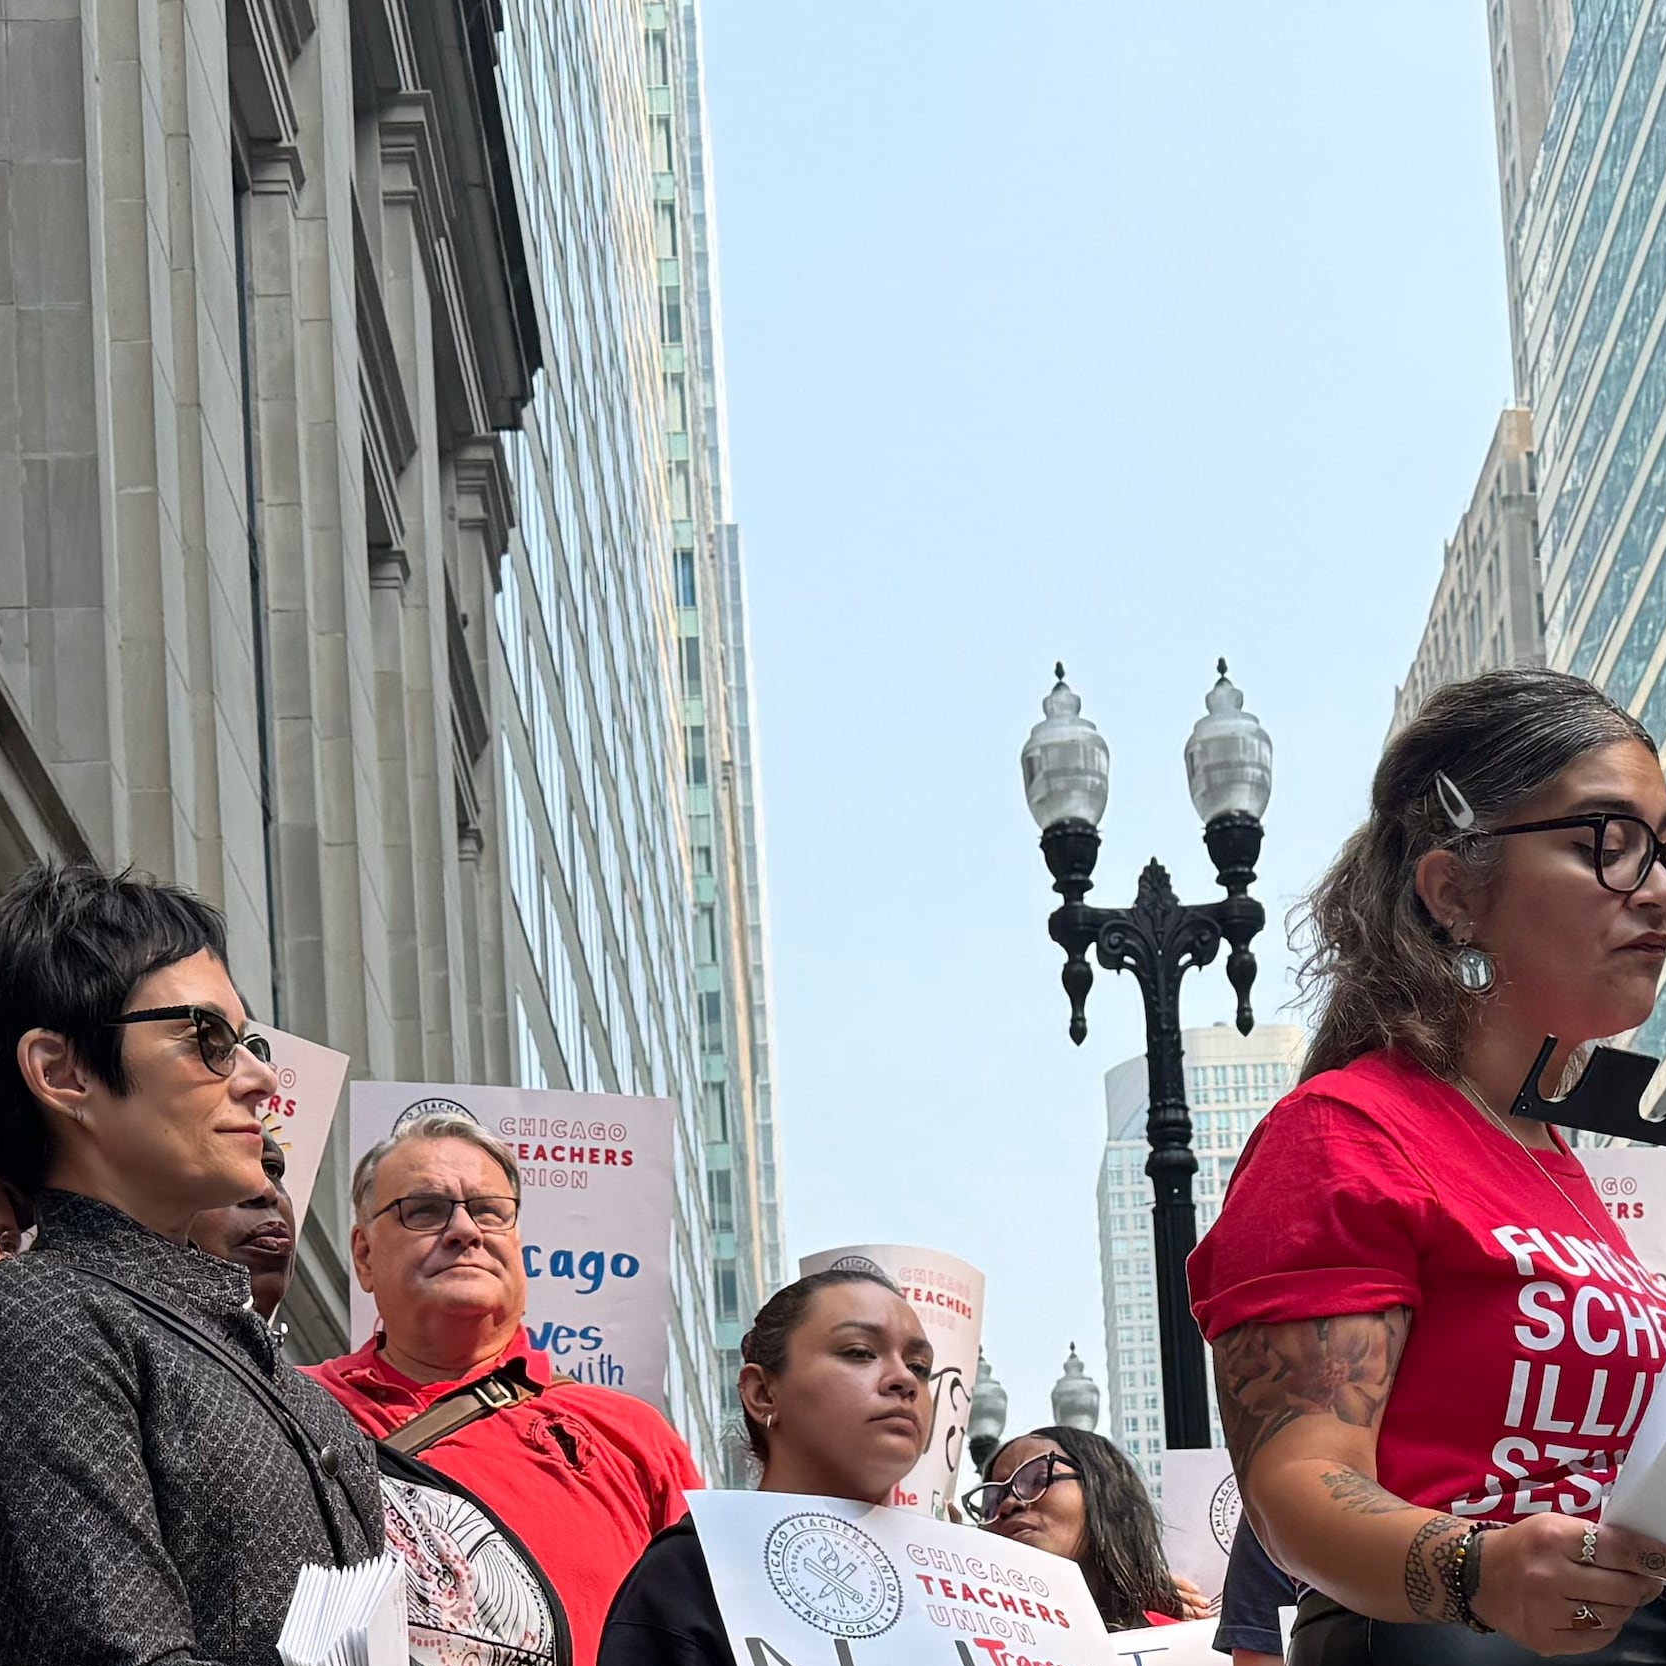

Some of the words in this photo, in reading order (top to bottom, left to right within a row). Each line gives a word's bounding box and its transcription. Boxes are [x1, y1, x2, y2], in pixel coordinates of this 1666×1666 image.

[499, 1116, 628, 1143] CHICAGO
[504, 1142, 634, 1167] EACHERS
[519, 1167, 589, 1189] NION
[521, 1245, 640, 1295] cago
[900, 1286, 973, 1321] TEACHERS
[1503, 1359, 1661, 1438] ILLI
[1214, 1480, 1235, 1536] CHICAGO
[770, 1531, 793, 1598] CHICAGO
[789, 1517, 871, 1549] TEACHERS
[873, 1552, 898, 1604] UNION
[906, 1543, 1050, 1598] CHICAGO
[802, 1609, 832, 1628] AFT
[836, 1621, 882, 1634] LOCAL
[915, 1573, 1071, 1629] TEACHERS
[927, 1604, 1037, 1646] UNION
